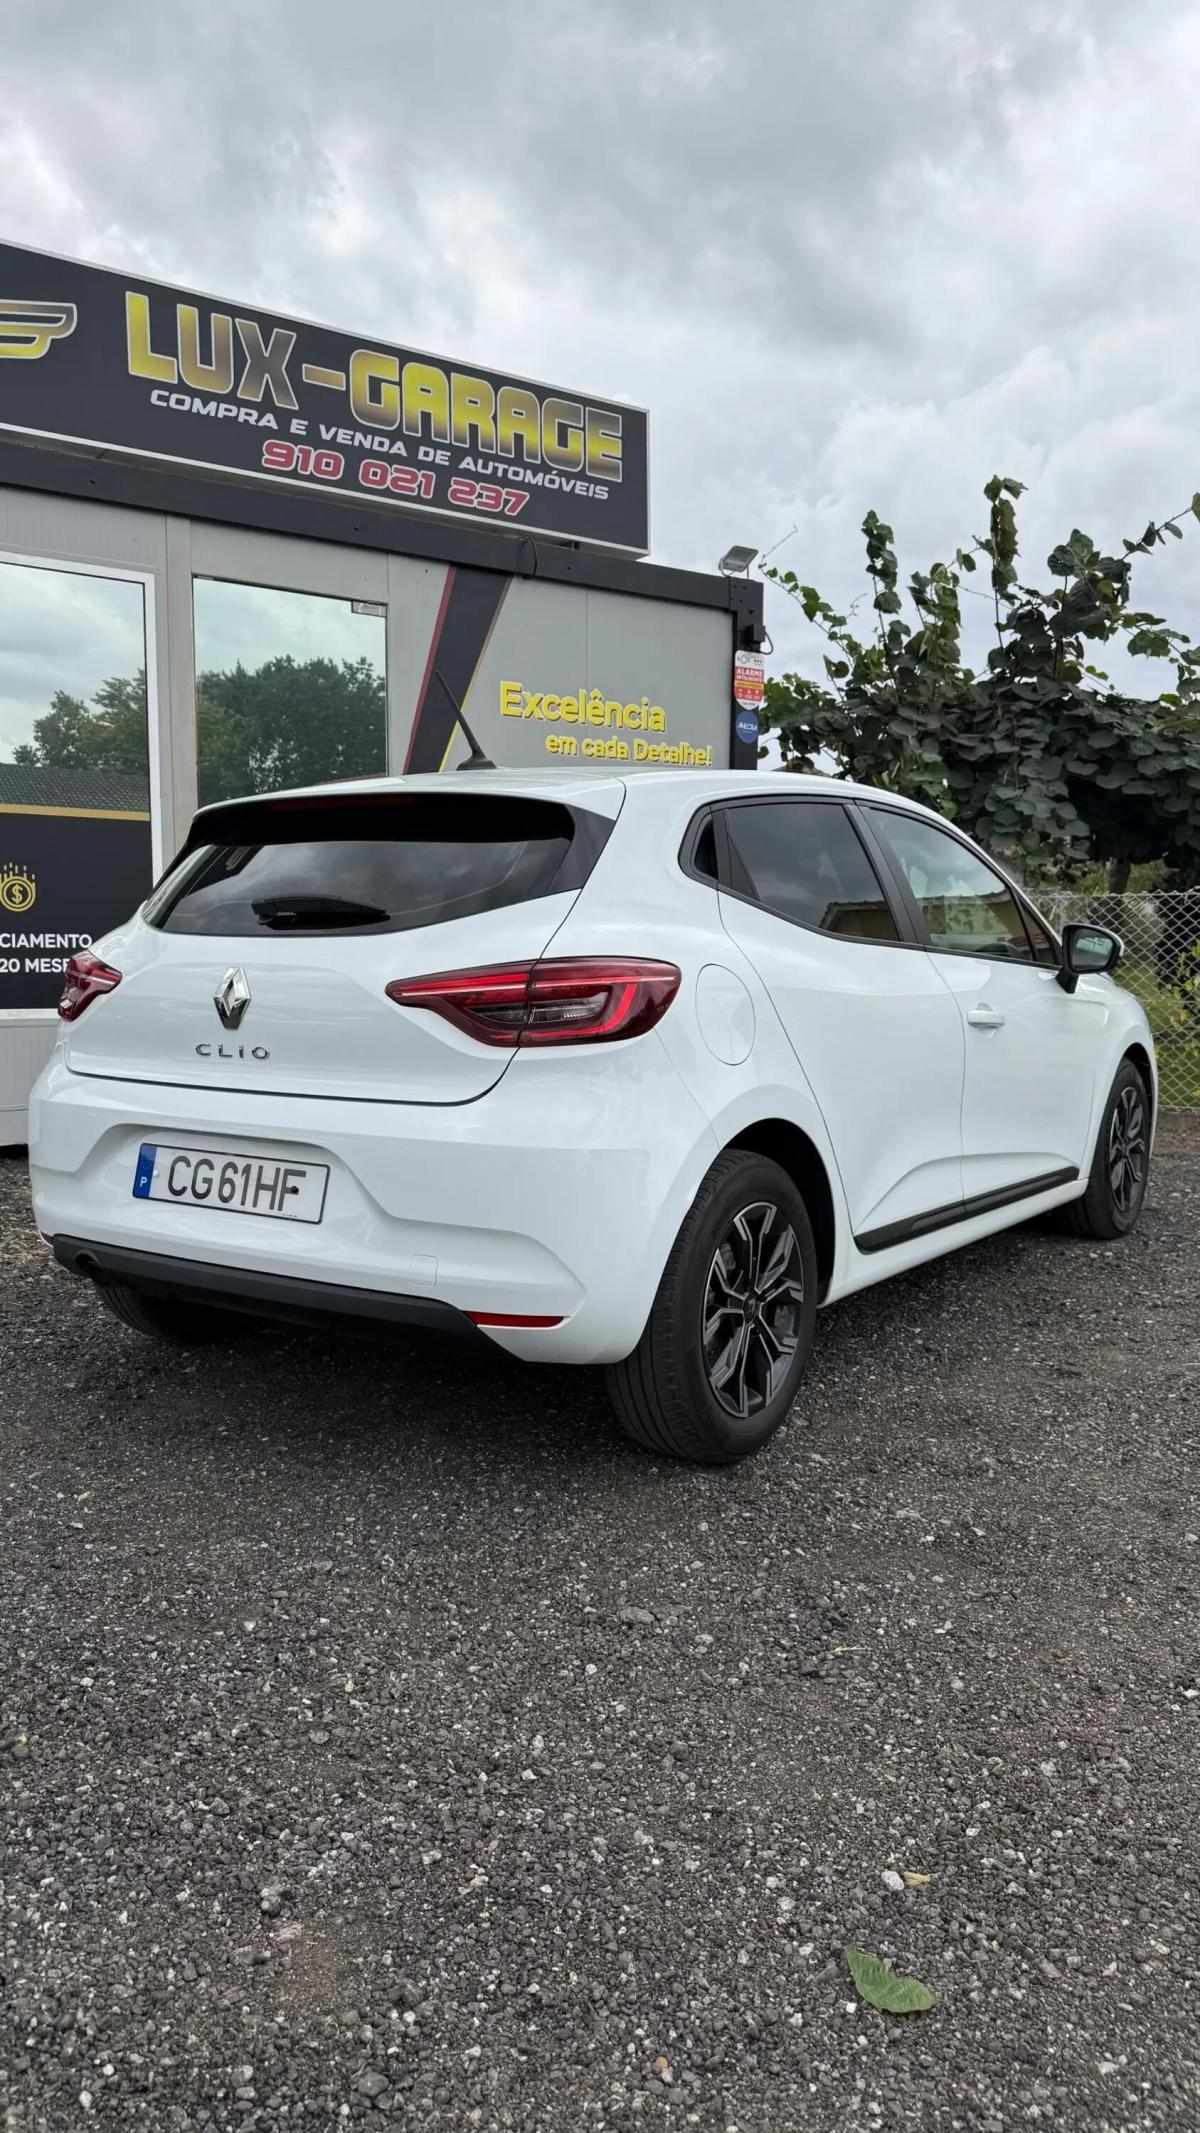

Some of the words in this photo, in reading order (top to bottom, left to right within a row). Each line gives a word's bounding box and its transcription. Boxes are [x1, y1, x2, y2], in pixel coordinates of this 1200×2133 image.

[125, 291, 623, 482] LUX-GARAGE
[150, 389, 278, 430] COMPRA
[290, 418, 309, 435] E
[319, 424, 407, 456] VENDA
[417, 445, 451, 466] DE
[459, 456, 609, 500] AUTOMÓVEIS
[262, 439, 344, 480] 910
[359, 459, 436, 498] 021
[448, 477, 529, 516] 237
[500, 680, 667, 733] Excelência
[545, 734, 577, 756] em
[582, 735, 629, 760] cada
[633, 738, 712, 767] Detalhe!
[0, 933, 92, 948] CIAMENTO
[195, 1043, 270, 1060] CLIO
[139, 1176, 148, 1188] P
[167, 1155, 306, 1212] CG61HF
